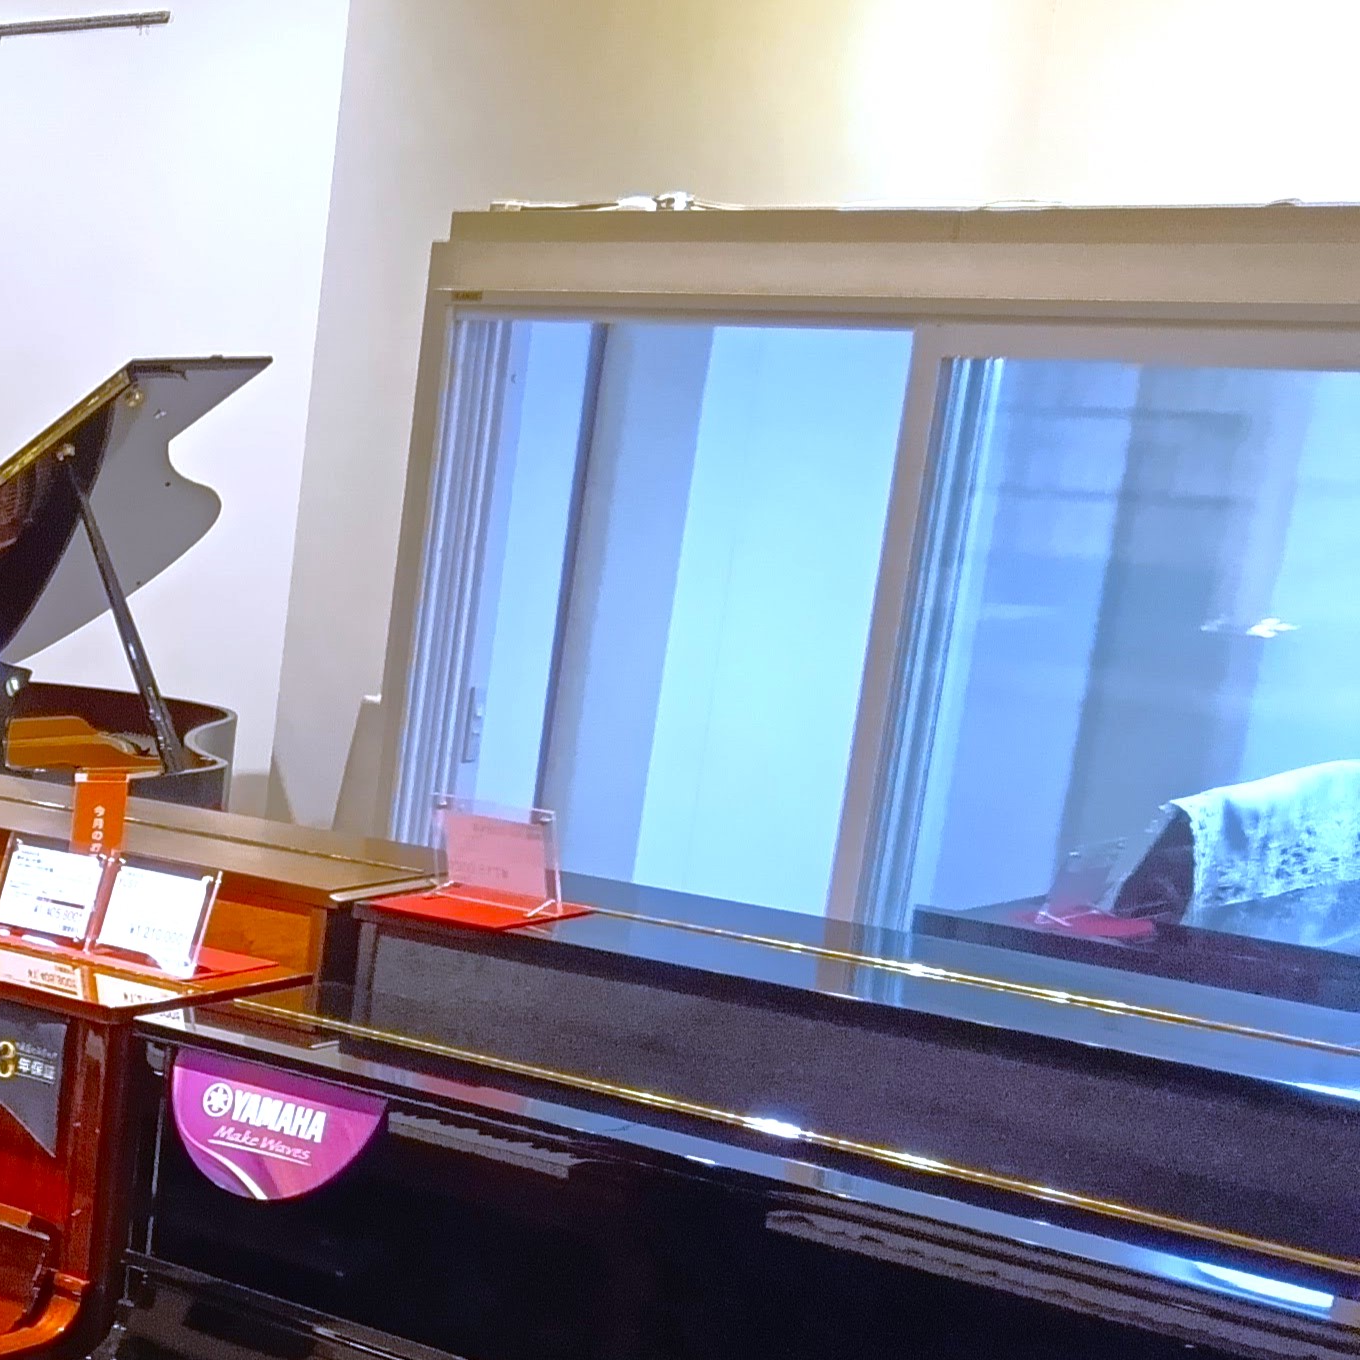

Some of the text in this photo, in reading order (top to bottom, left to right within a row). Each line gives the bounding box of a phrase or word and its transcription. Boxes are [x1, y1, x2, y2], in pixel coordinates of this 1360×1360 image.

[231, 1089, 326, 1143] YAMAHA
[213, 1125, 311, 1160] Make Waves
